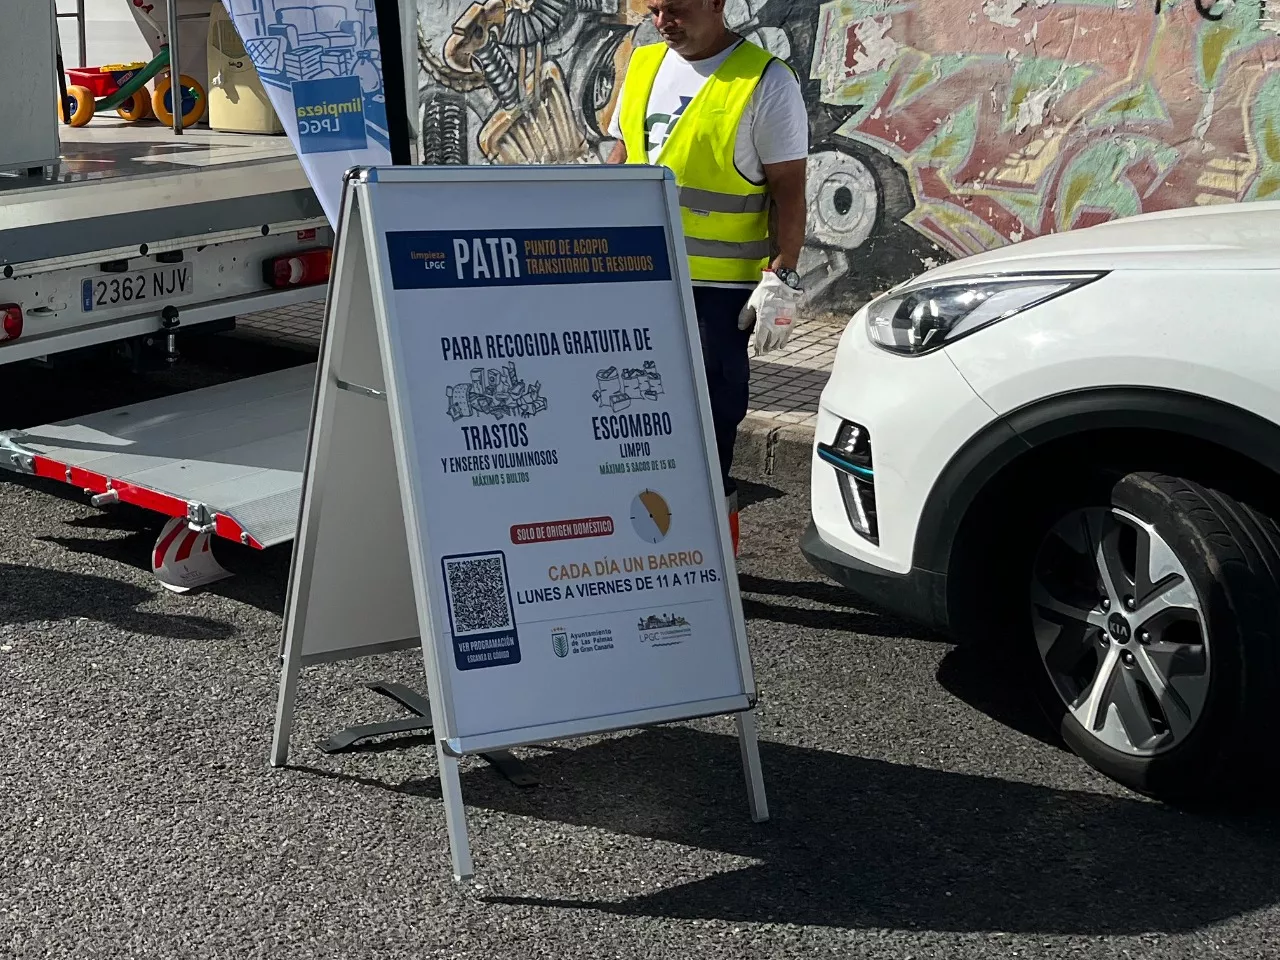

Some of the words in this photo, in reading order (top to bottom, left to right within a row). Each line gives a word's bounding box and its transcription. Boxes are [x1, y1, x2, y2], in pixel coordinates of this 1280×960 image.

[411, 251, 445, 260] limpieza
[524, 240, 556, 256] PUNTO
[559, 239, 571, 255] DE
[574, 238, 608, 254] ACOPIO
[425, 261, 445, 270] LPGC
[453, 237, 520, 279] PATR
[526, 257, 589, 274] TRANSITORIO
[592, 257, 604, 272] DE
[606, 256, 654, 272] RESIDUOS
[97, 275, 146, 305] 2362
[153, 268, 187, 296] NJV
[441, 336, 483, 360] PARA
[485, 332, 560, 359] RECOGIDA
[563, 329, 632, 355] GRATUITA
[633, 327, 653, 351] DE
[592, 411, 672, 440] ESCOMBRO
[461, 422, 529, 450] TRASTOS
[619, 442, 651, 458] LIMPIO
[440, 457, 447, 473] Y
[450, 454, 490, 472] ENSERES
[492, 449, 558, 469] VOLUMINOSOS
[625, 463, 631, 473] 5
[631, 461, 650, 473] SACOS
[651, 460, 659, 470] DE
[660, 460, 667, 470] 15
[500, 473, 506, 484] 5
[506, 472, 530, 483] BULTOS
[517, 527, 535, 540] SOLO
[536, 526, 545, 538] DE
[546, 524, 572, 537] ORIGEN
[573, 519, 612, 535] DOMÉSTICO
[548, 562, 592, 581] CADA
[595, 556, 620, 576] DÍA
[623, 557, 643, 573] UN
[648, 550, 703, 570] BARRIO
[517, 587, 561, 604] LUNES
[565, 585, 575, 599] A
[576, 579, 632, 597] VIERNES
[636, 576, 653, 590] DE
[657, 574, 668, 588] 11
[672, 573, 682, 587] A
[684, 571, 697, 585] 17
[701, 569, 721, 584] HS.
[570, 629, 612, 640] Ayuntamiento
[1110, 621, 1128, 637] KIA
